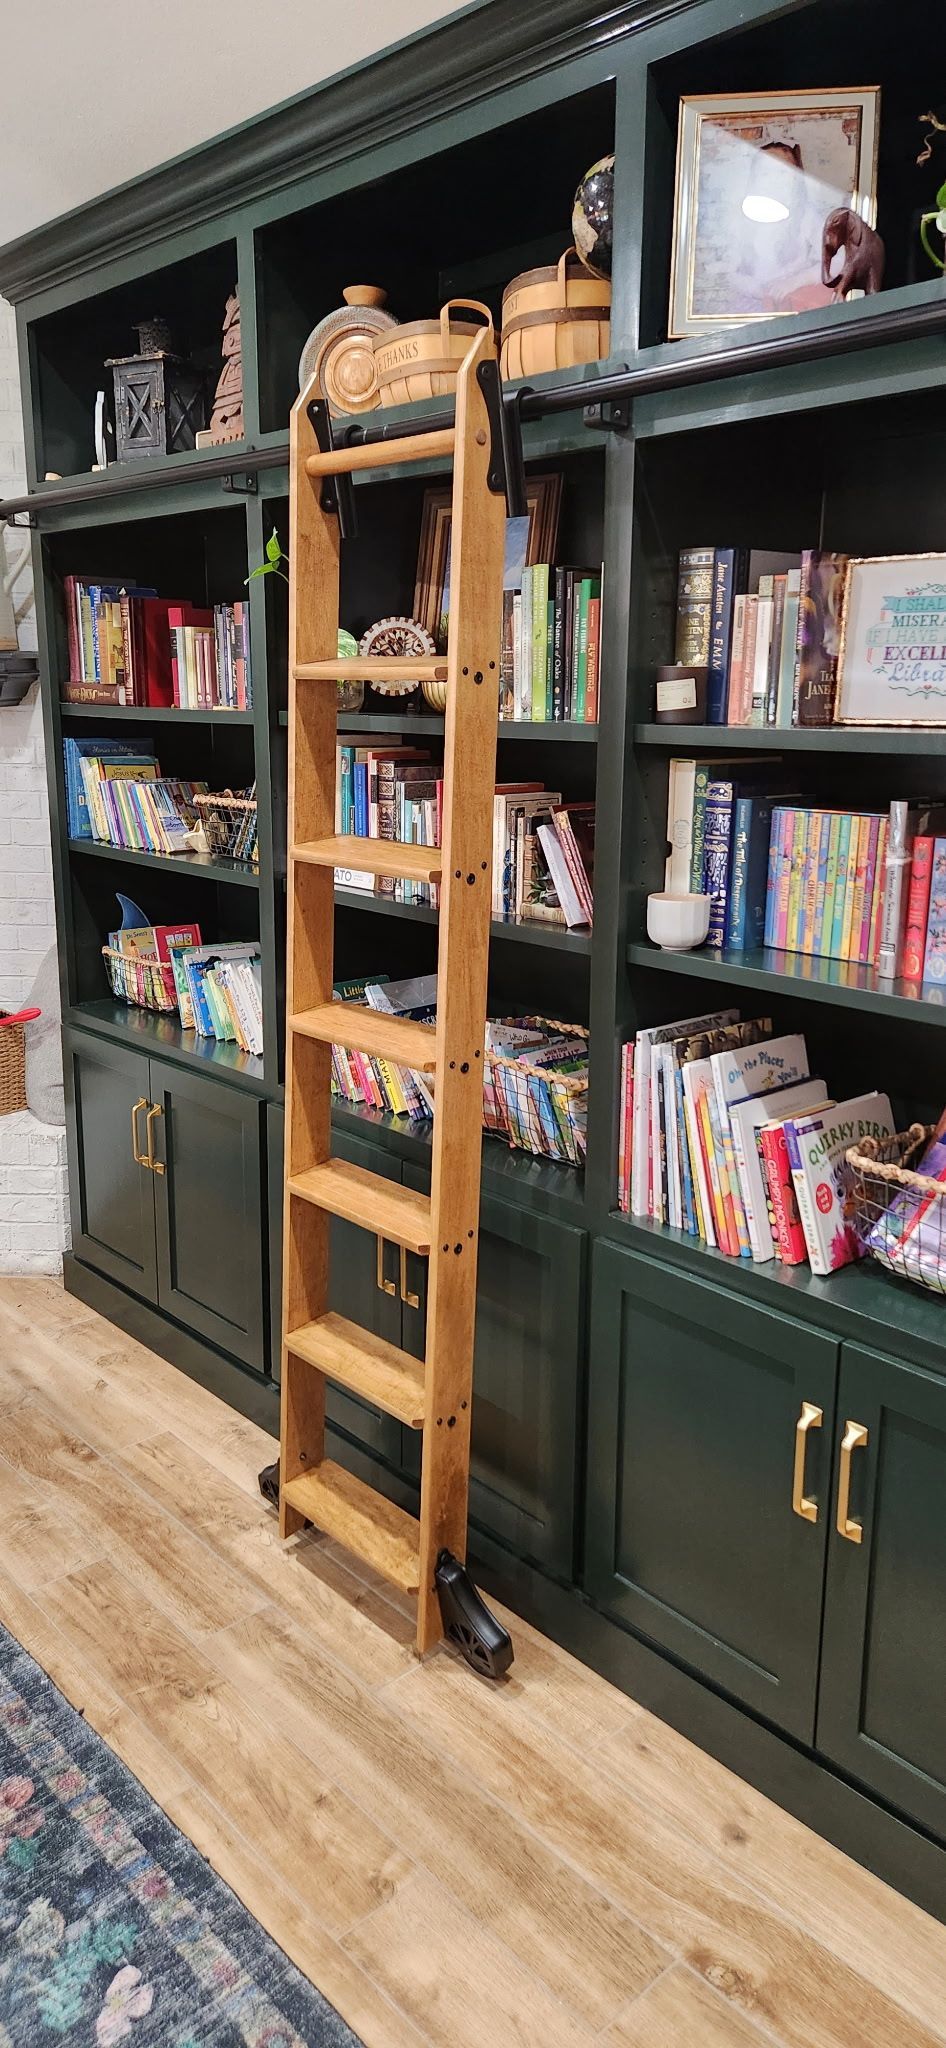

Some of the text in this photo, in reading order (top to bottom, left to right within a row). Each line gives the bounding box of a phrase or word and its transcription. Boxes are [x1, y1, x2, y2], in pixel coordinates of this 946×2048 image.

[383, 342, 418, 369] THANKS
[712, 562, 728, 670] Jane Austen EMM
[896, 599, 901, 611] I
[868, 629, 938, 642] IF I HAVE
[805, 681, 829, 700] JANE
[694, 835, 703, 855] Witch
[737, 831, 748, 848] The
[735, 849, 746, 866] Tale
[735, 868, 745, 877] of
[731, 878, 745, 926] Despereaux
[780, 876, 789, 913] MATILDA
[807, 880, 815, 907] CHARLIE
[343, 986, 364, 997] Little
[379, 1058, 391, 1084] MAD
[728, 1067, 744, 1083] Oh,
[744, 1059, 757, 1071] the
[758, 1051, 784, 1068] Places
[808, 1121, 854, 1165] QUIRKY
[858, 1119, 889, 1138] BIRD
[768, 1160, 792, 1249] GRUMPY MONKEY
